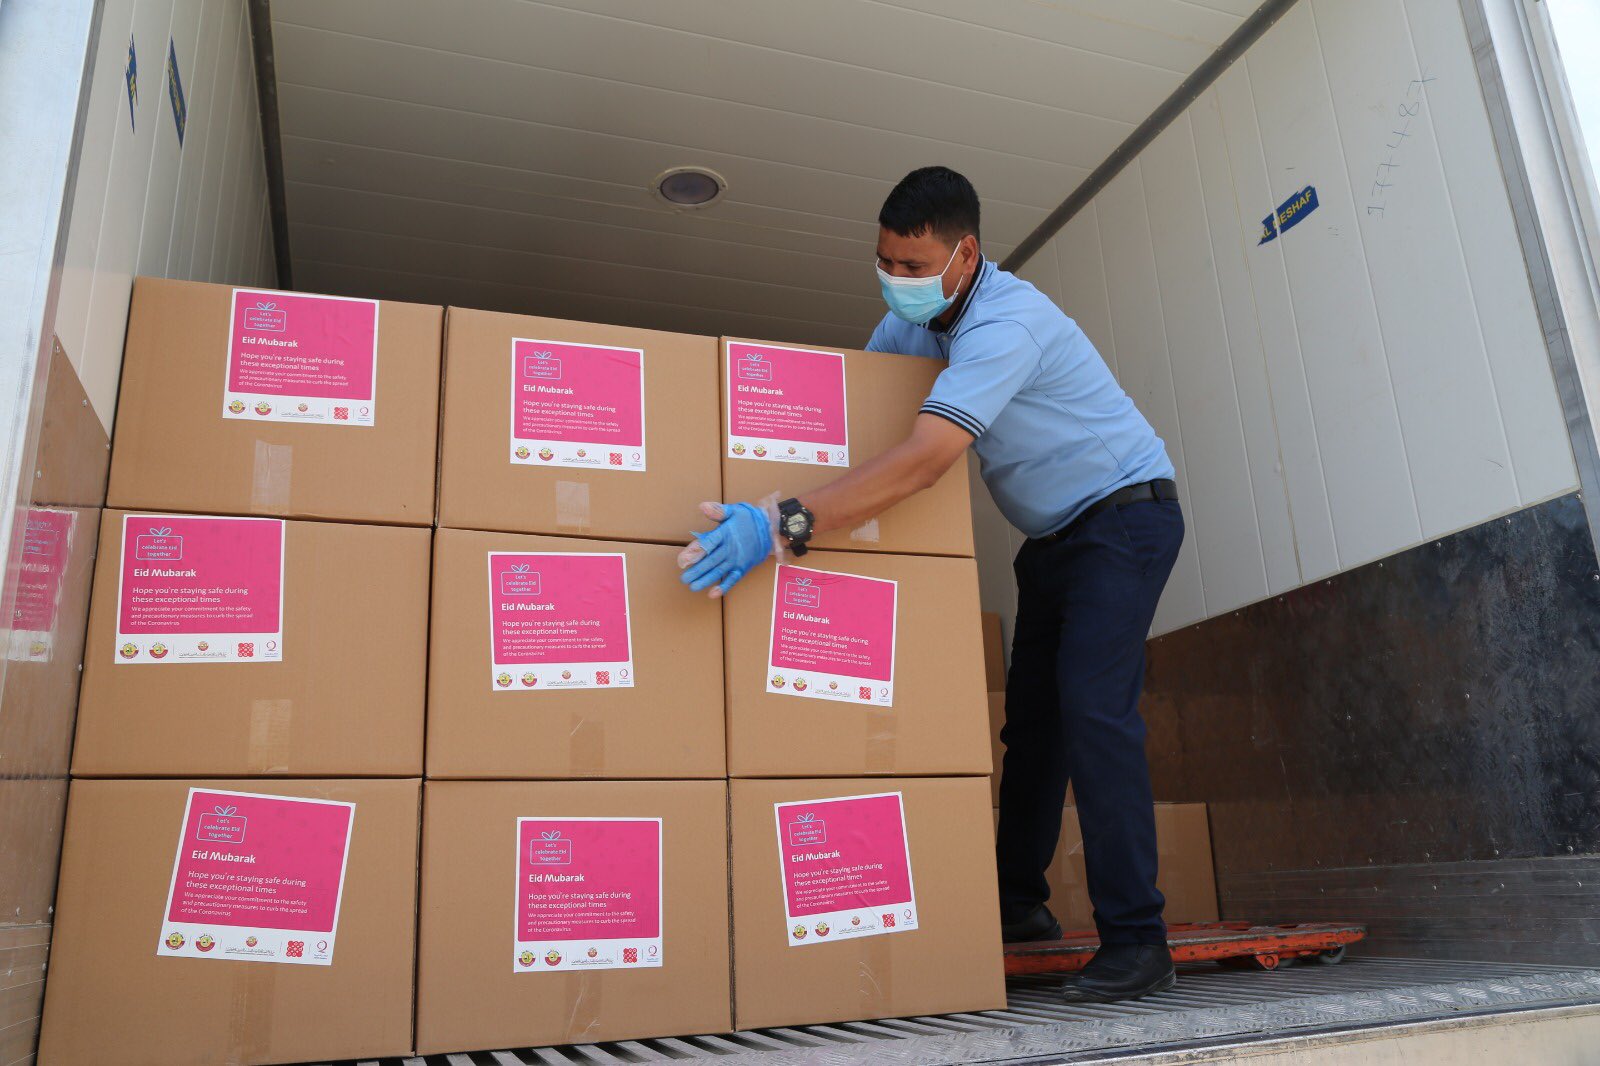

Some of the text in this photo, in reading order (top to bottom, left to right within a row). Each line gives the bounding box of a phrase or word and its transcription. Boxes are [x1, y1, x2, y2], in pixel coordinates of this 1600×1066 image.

[242, 336, 298, 347] Eid Mubarak
[323, 358, 344, 366] during
[537, 385, 573, 394] Mubarak
[750, 386, 783, 395] Mubarak
[596, 405, 616, 413] during
[134, 568, 196, 577] Eid Mubarak
[224, 587, 248, 595] during
[783, 611, 829, 624] Eid Mubarak
[798, 638, 831, 646] exceptional
[817, 633, 837, 641] staying
[850, 637, 868, 645] during
[192, 850, 255, 863] Eid Mubarak
[791, 850, 840, 862] Eid Mubarak
[529, 873, 584, 882] Eid Mubarak
[810, 869, 829, 877] you're
[188, 871, 209, 879] Hope
[210, 872, 235, 880] you're
[236, 875, 263, 884] staying
[281, 878, 306, 887] during
[812, 875, 845, 884] exceptional
[186, 880, 208, 888] these
[209, 883, 254, 892] exceptional
[528, 893, 547, 901] Hope
[548, 892, 569, 900] you're
[548, 901, 587, 909] exceptional
[198, 908, 231, 916] Coronavirus
